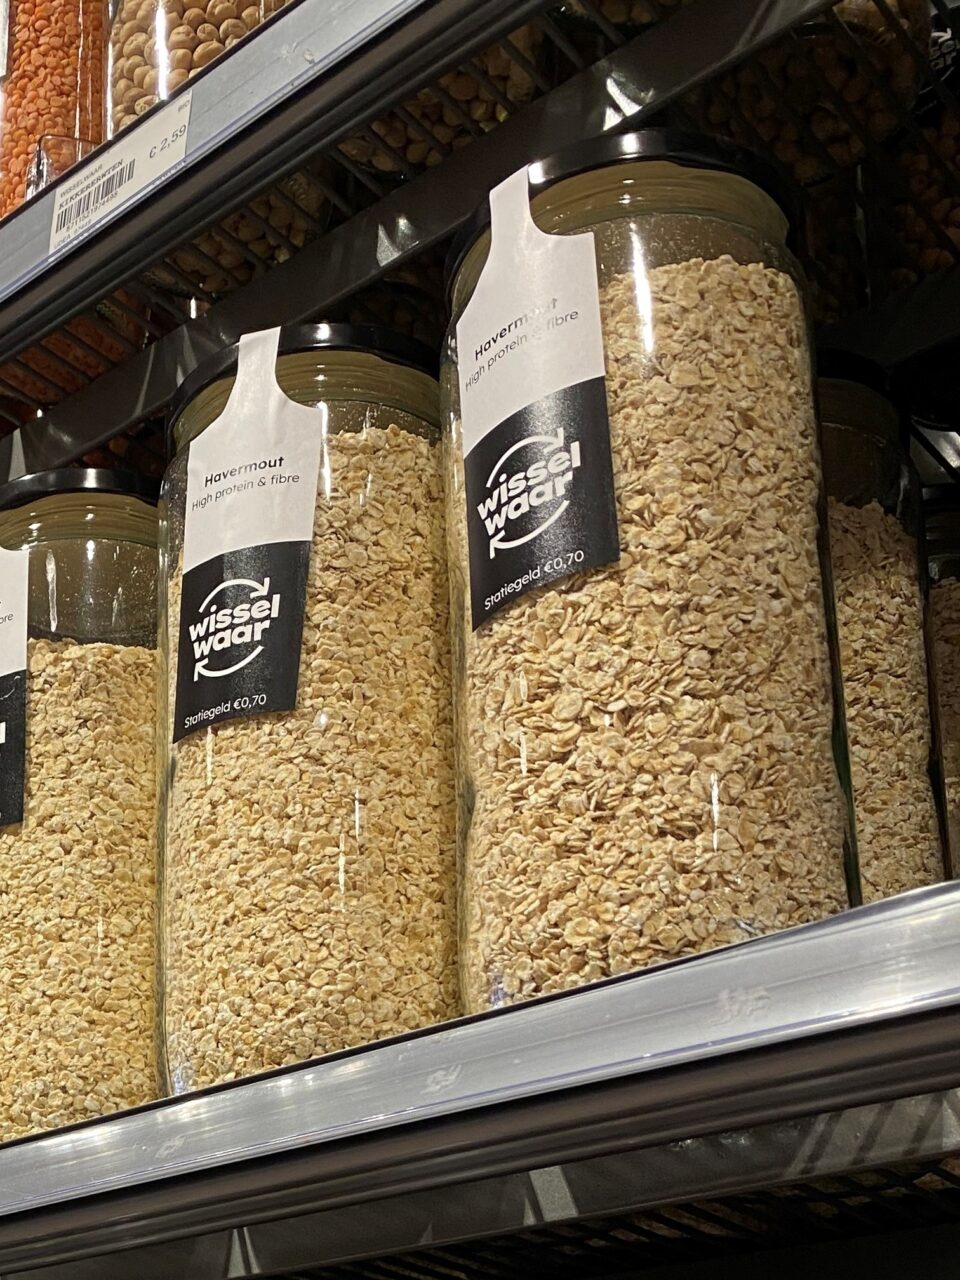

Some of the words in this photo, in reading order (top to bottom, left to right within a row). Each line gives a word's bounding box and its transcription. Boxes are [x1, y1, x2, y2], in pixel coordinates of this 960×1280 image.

[464, 363, 486, 392] High
[487, 333, 529, 372] protein
[546, 309, 580, 338] fibre
[191, 492, 213, 512] High
[215, 479, 254, 500] protein
[257, 476, 267, 487] &
[270, 472, 301, 485] fibre
[204, 456, 285, 489] Havermout
[476, 440, 582, 521] wissel
[483, 470, 574, 537] waar
[483, 566, 541, 611] Statiegeld
[543, 550, 585, 574] €0,70
[188, 593, 281, 643] wissel
[193, 619, 271, 660] waar
[184, 699, 231, 729] Statiegeld
[233, 693, 267, 712] €0,70
